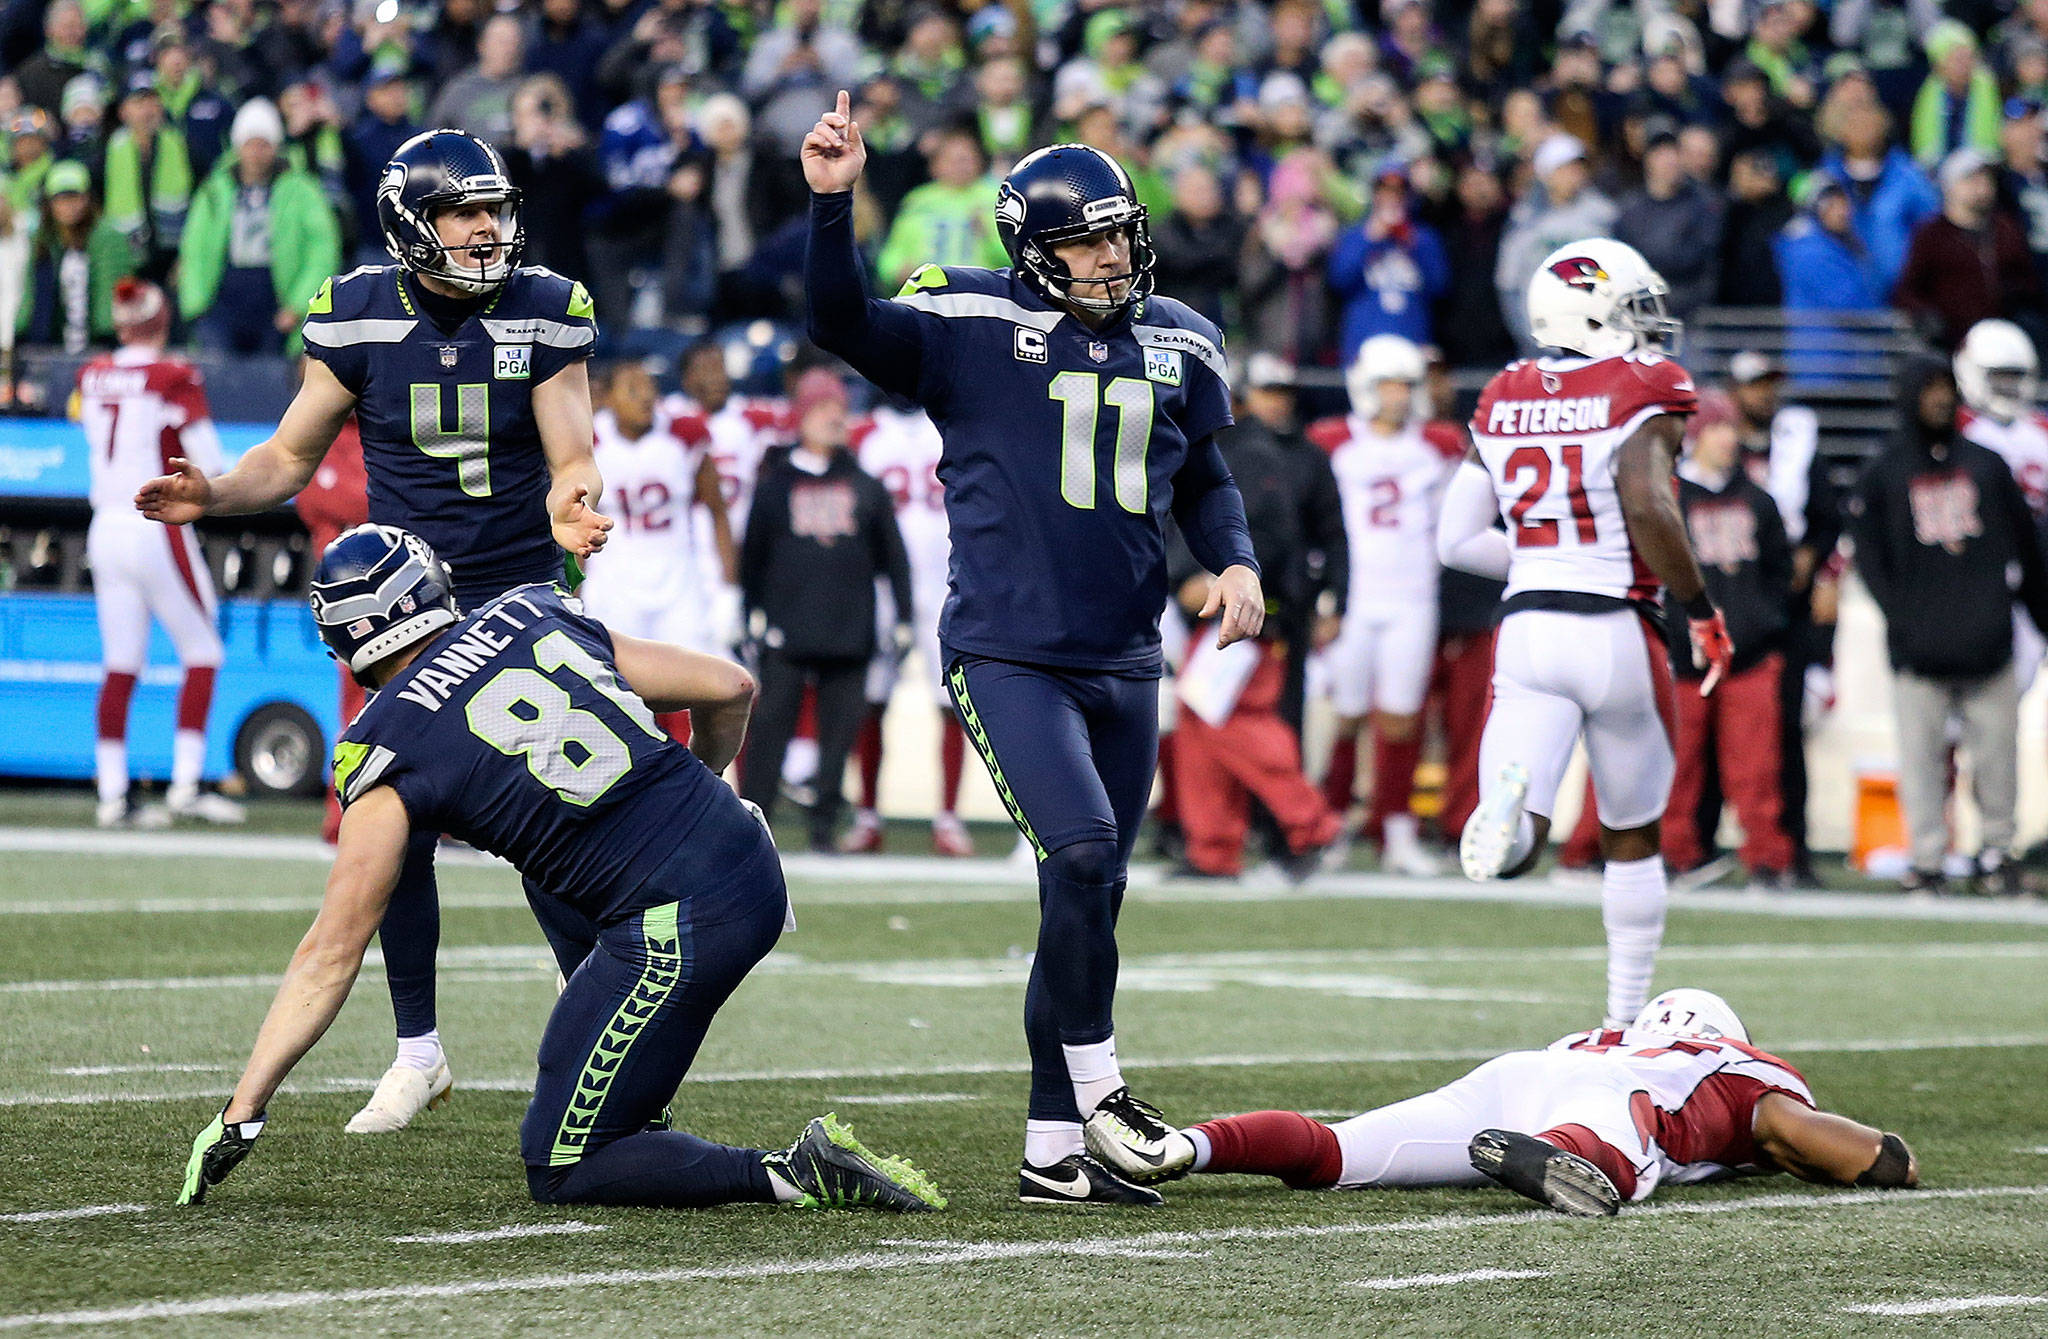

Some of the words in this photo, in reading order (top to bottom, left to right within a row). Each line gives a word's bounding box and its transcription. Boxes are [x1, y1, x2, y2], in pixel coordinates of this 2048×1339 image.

[498, 360, 529, 374] PGA
[1017, 328, 1046, 354] C
[1148, 361, 1178, 380] PGA
[101, 403, 120, 462] 7
[410, 383, 492, 497] 4
[1487, 396, 1611, 434] PETERSON
[1048, 371, 1154, 514] 11
[616, 481, 672, 533] 12
[1369, 477, 1401, 529] 2
[1504, 444, 1598, 548] 21
[367, 618, 431, 656] SEATTLE
[397, 592, 544, 712] VANNETT
[464, 630, 669, 807] 81
